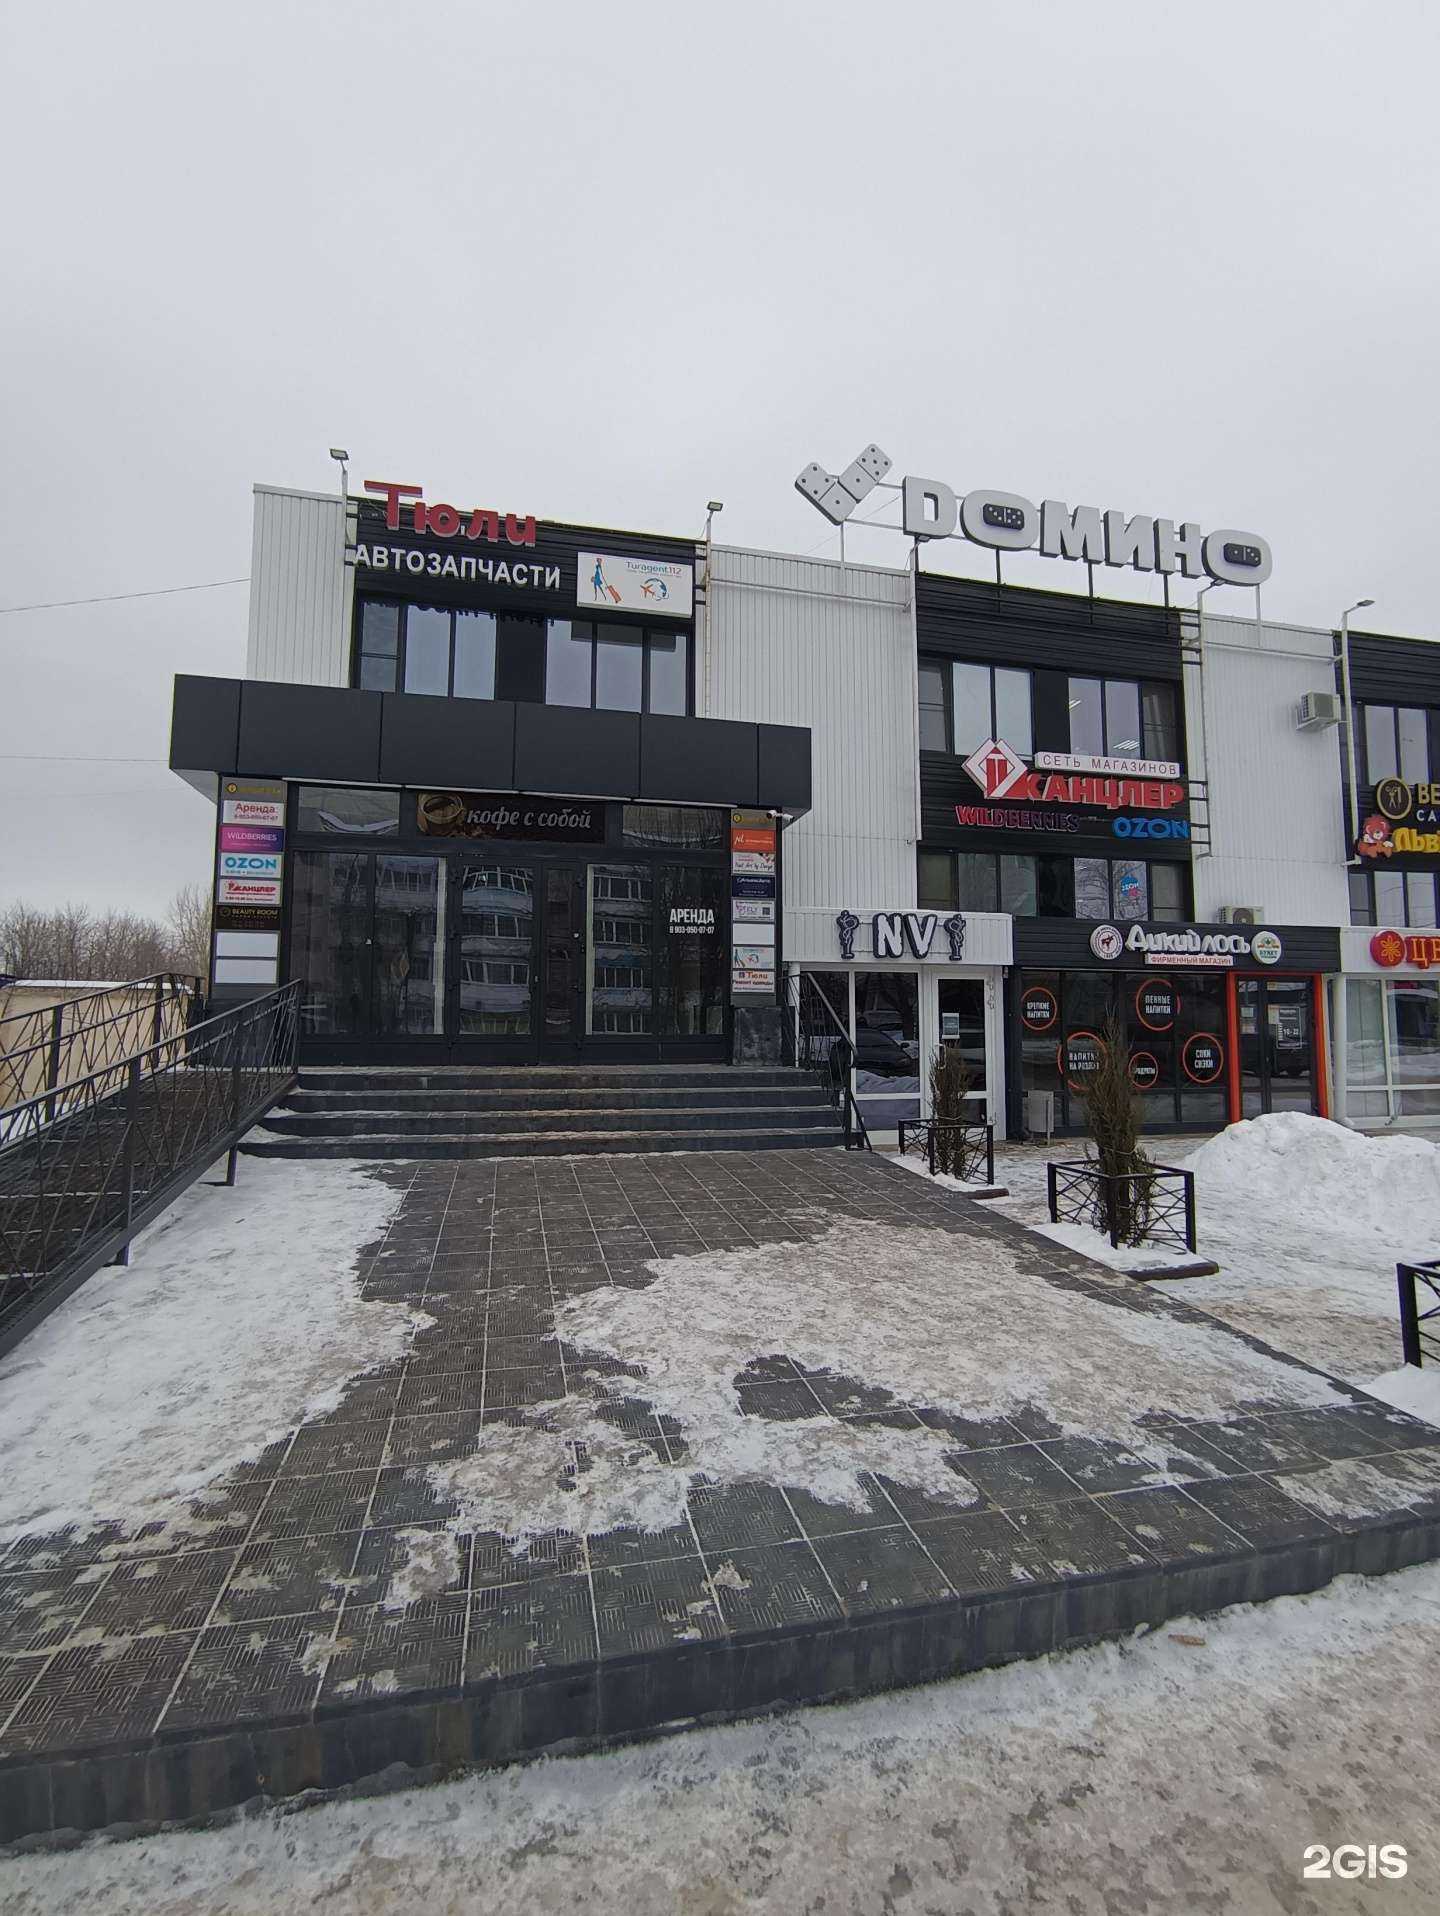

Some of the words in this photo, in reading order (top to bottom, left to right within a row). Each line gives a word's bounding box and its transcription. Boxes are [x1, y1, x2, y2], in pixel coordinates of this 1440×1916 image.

[364, 480, 536, 547] Тюли
[354, 544, 561, 591] АВТОЗАПЧАСТИ
[626, 561, 682, 575] Turagent112
[1043, 757, 1081, 768] СЕТЬ
[1091, 758, 1177, 775] МАГАЗИНОВ
[1012, 772, 1185, 809] КАНЦЛЕР
[235, 803, 276, 814] Аренда
[467, 807, 519, 829] кофе
[523, 813, 535, 826] с
[538, 809, 592, 829] собой
[956, 806, 1081, 832] WILDBERRIES
[227, 832, 278, 841] WILDBERRIES
[1112, 817, 1189, 839] OZON
[225, 857, 277, 869] OZON
[669, 908, 715, 925] АРЕНДА
[872, 912, 938, 960] NV
[1125, 924, 1200, 952] Дикий
[1202, 935, 1251, 953] лось
[1151, 955, 1199, 964] ФИРМЕННЫЙ
[1200, 956, 1231, 965] МАГАЗИН
[1145, 994, 1171, 1004] ПЕННЫЕ
[1027, 1011, 1050, 1019] НАПИТКИ
[1145, 1004, 1171, 1015] НАПИТКИ
[1069, 1062, 1077, 1071] НА
